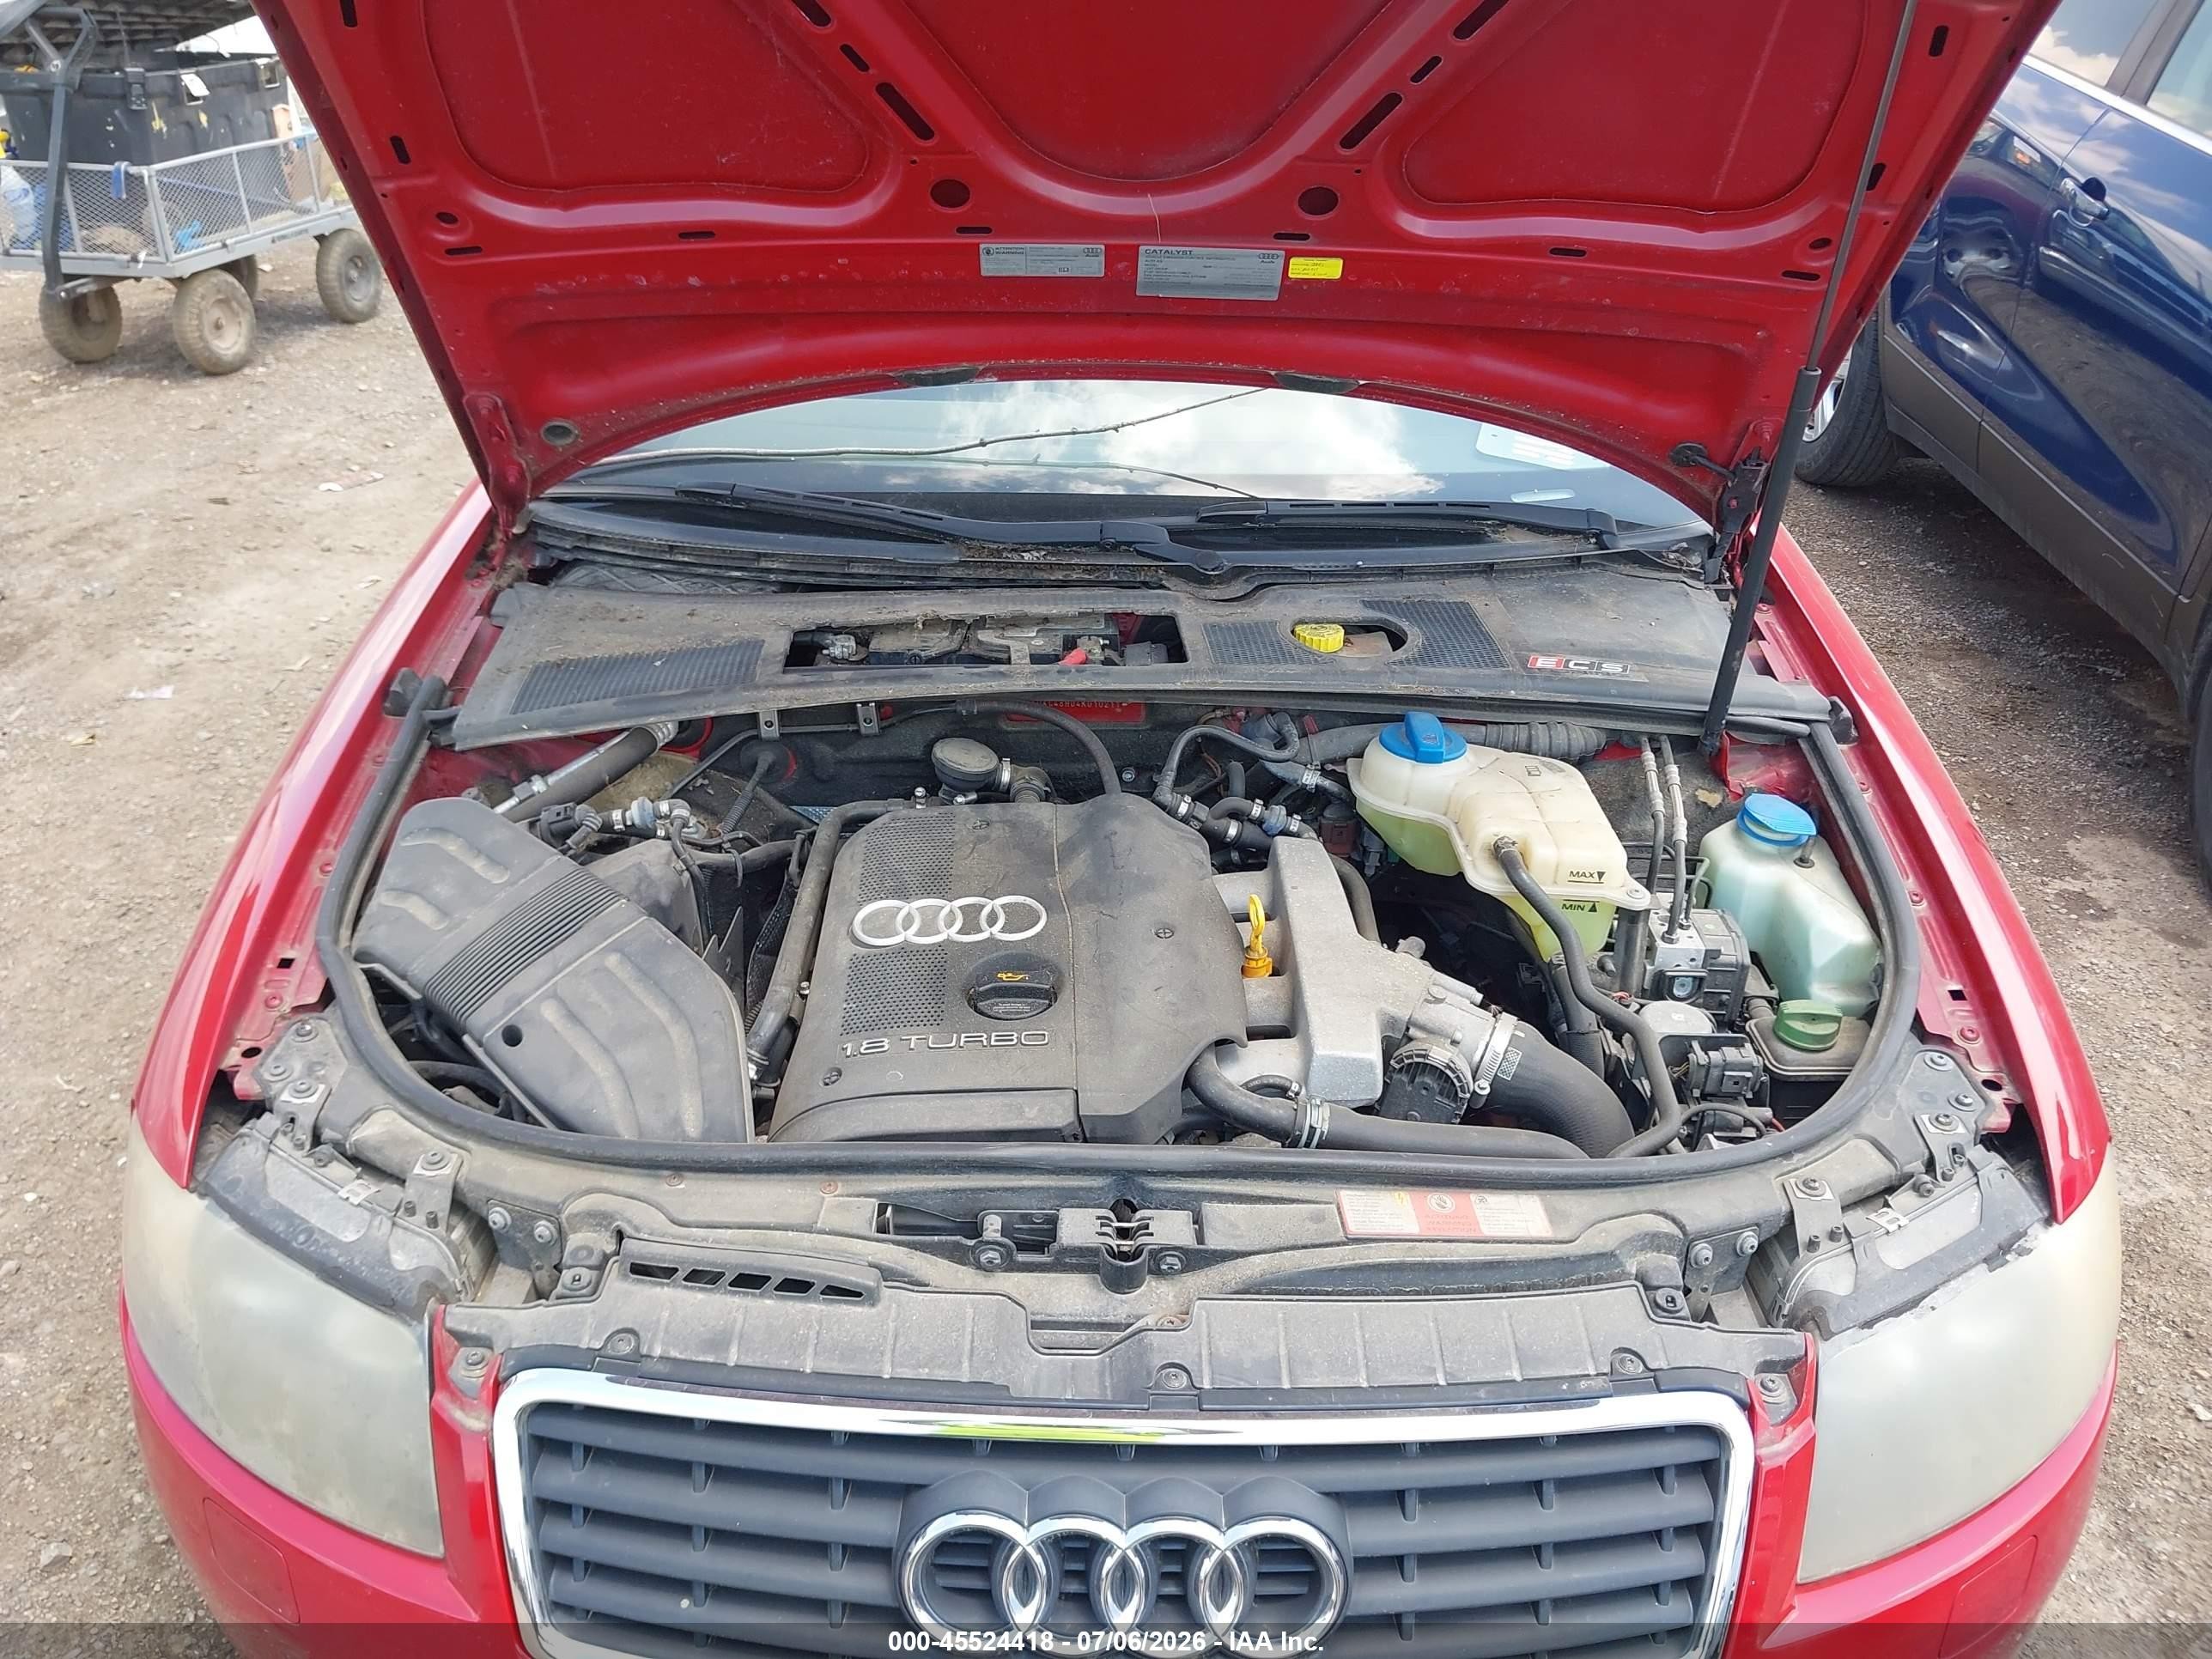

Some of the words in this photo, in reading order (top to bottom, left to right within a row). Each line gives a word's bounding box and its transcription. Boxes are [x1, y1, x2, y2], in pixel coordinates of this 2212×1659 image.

[1534, 657, 1621, 672] ECS
[842, 1037, 890, 1058] 1.8
[902, 1031, 1048, 1050] TURBO
